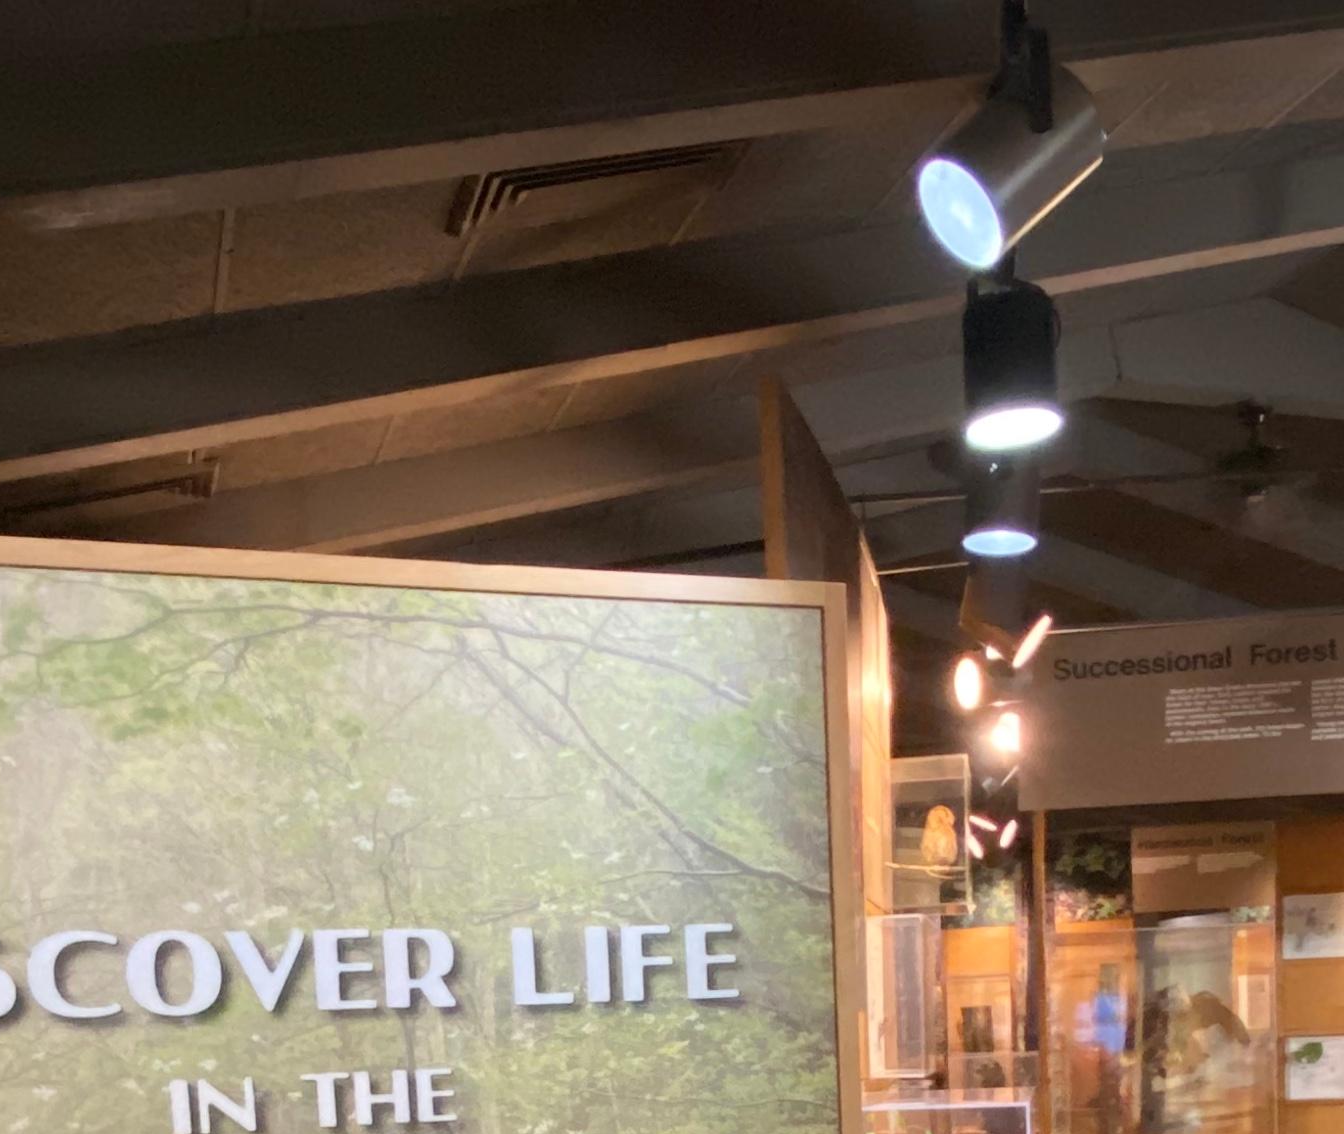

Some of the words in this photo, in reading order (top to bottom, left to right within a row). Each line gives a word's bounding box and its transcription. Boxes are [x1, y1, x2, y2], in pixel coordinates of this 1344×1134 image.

[1053, 645, 1233, 681] Successional
[1249, 638, 1340, 666] Forest
[510, 922, 740, 1006] LIFE
[300, 1067, 457, 1128] THE
